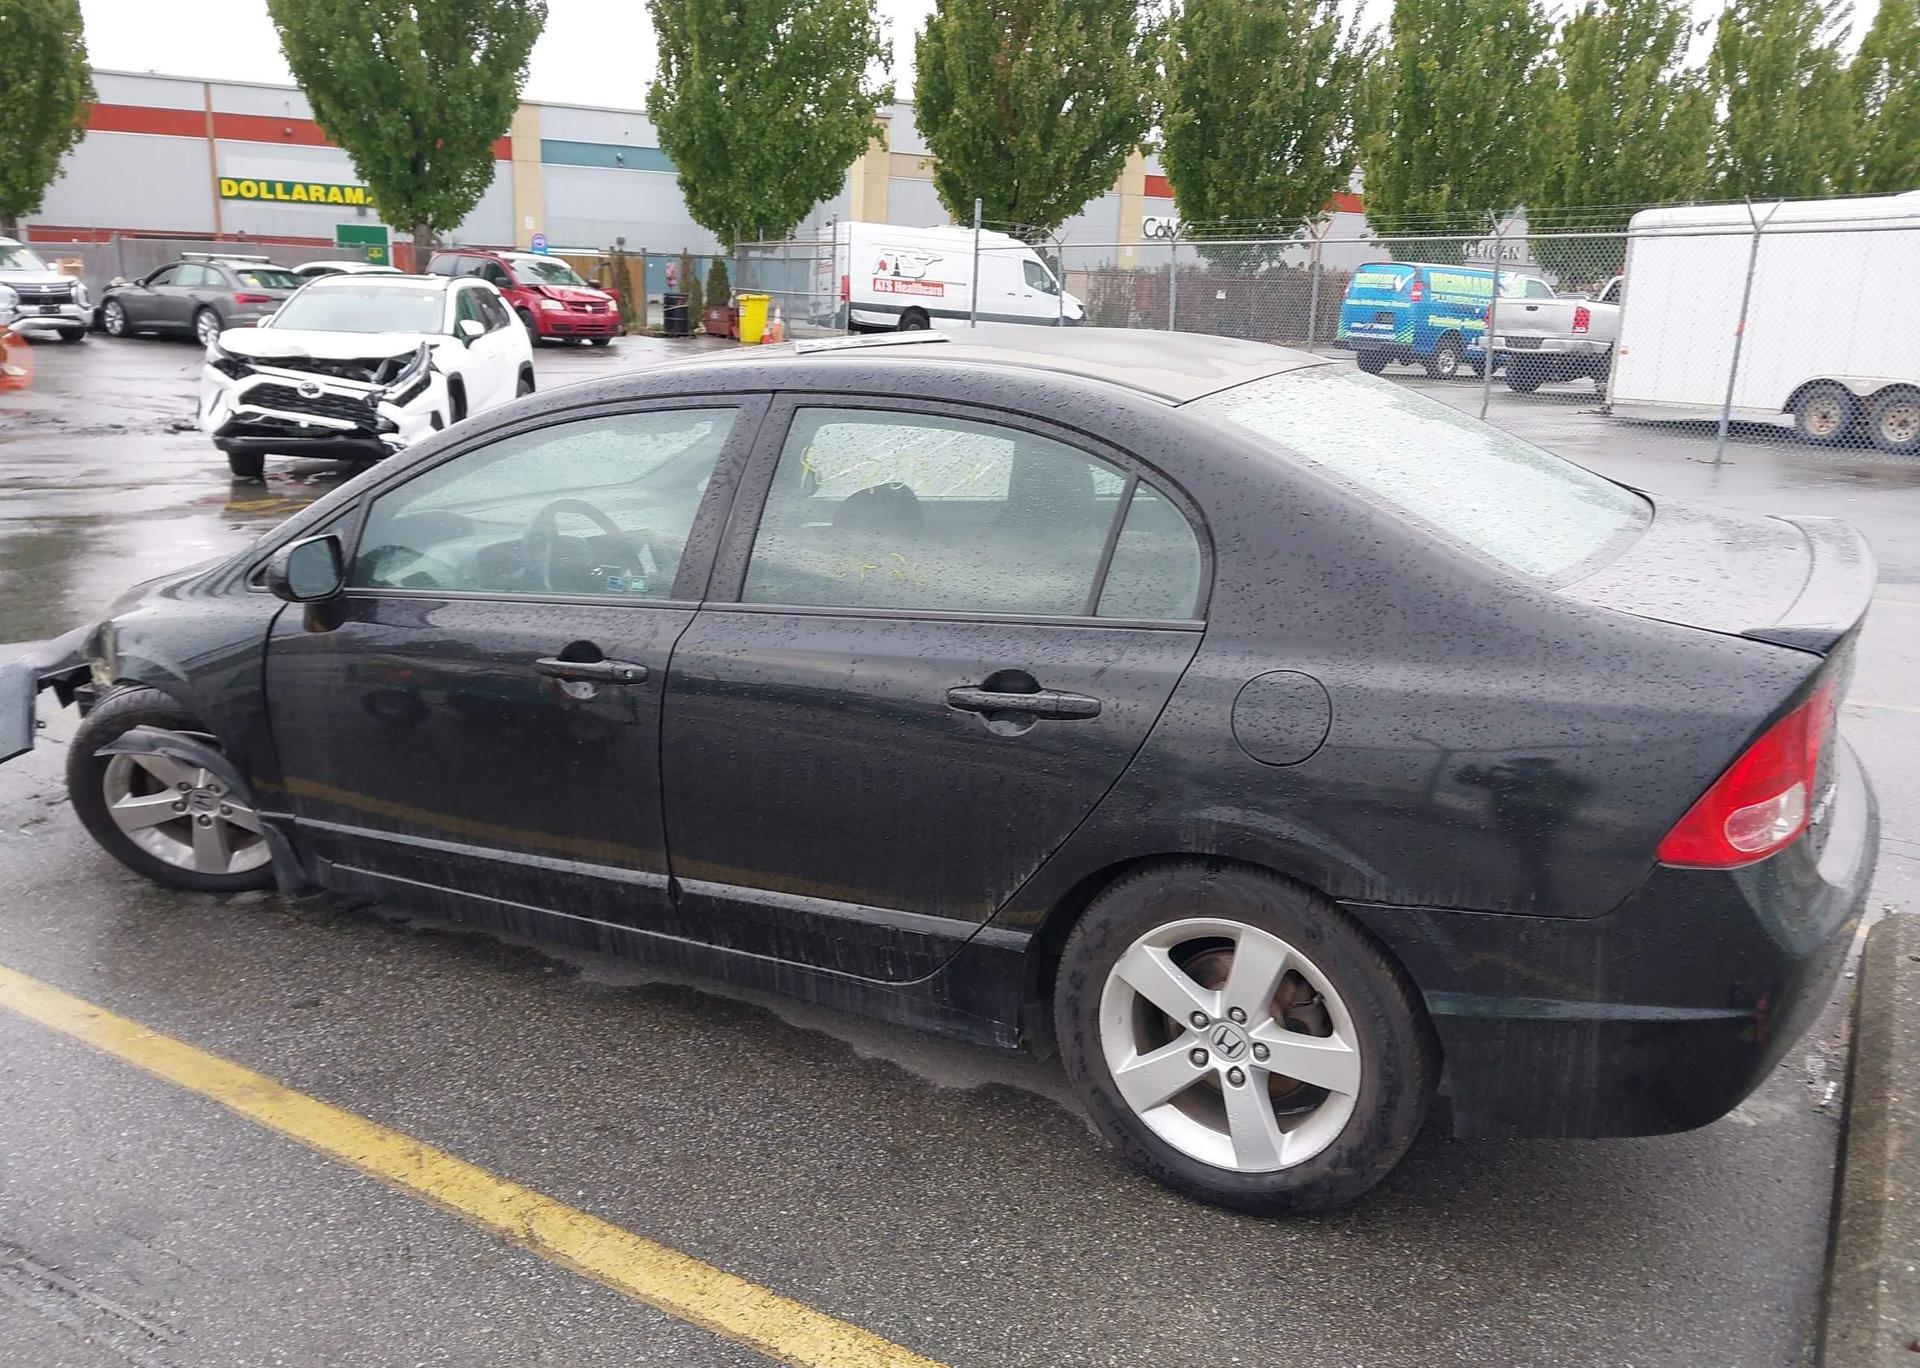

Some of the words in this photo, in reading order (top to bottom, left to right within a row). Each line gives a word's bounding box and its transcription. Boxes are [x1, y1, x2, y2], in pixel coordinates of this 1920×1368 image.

[220, 179, 373, 205] DOLLARAM
[874, 279, 893, 292] ATS
[894, 281, 943, 296] Healthcare
